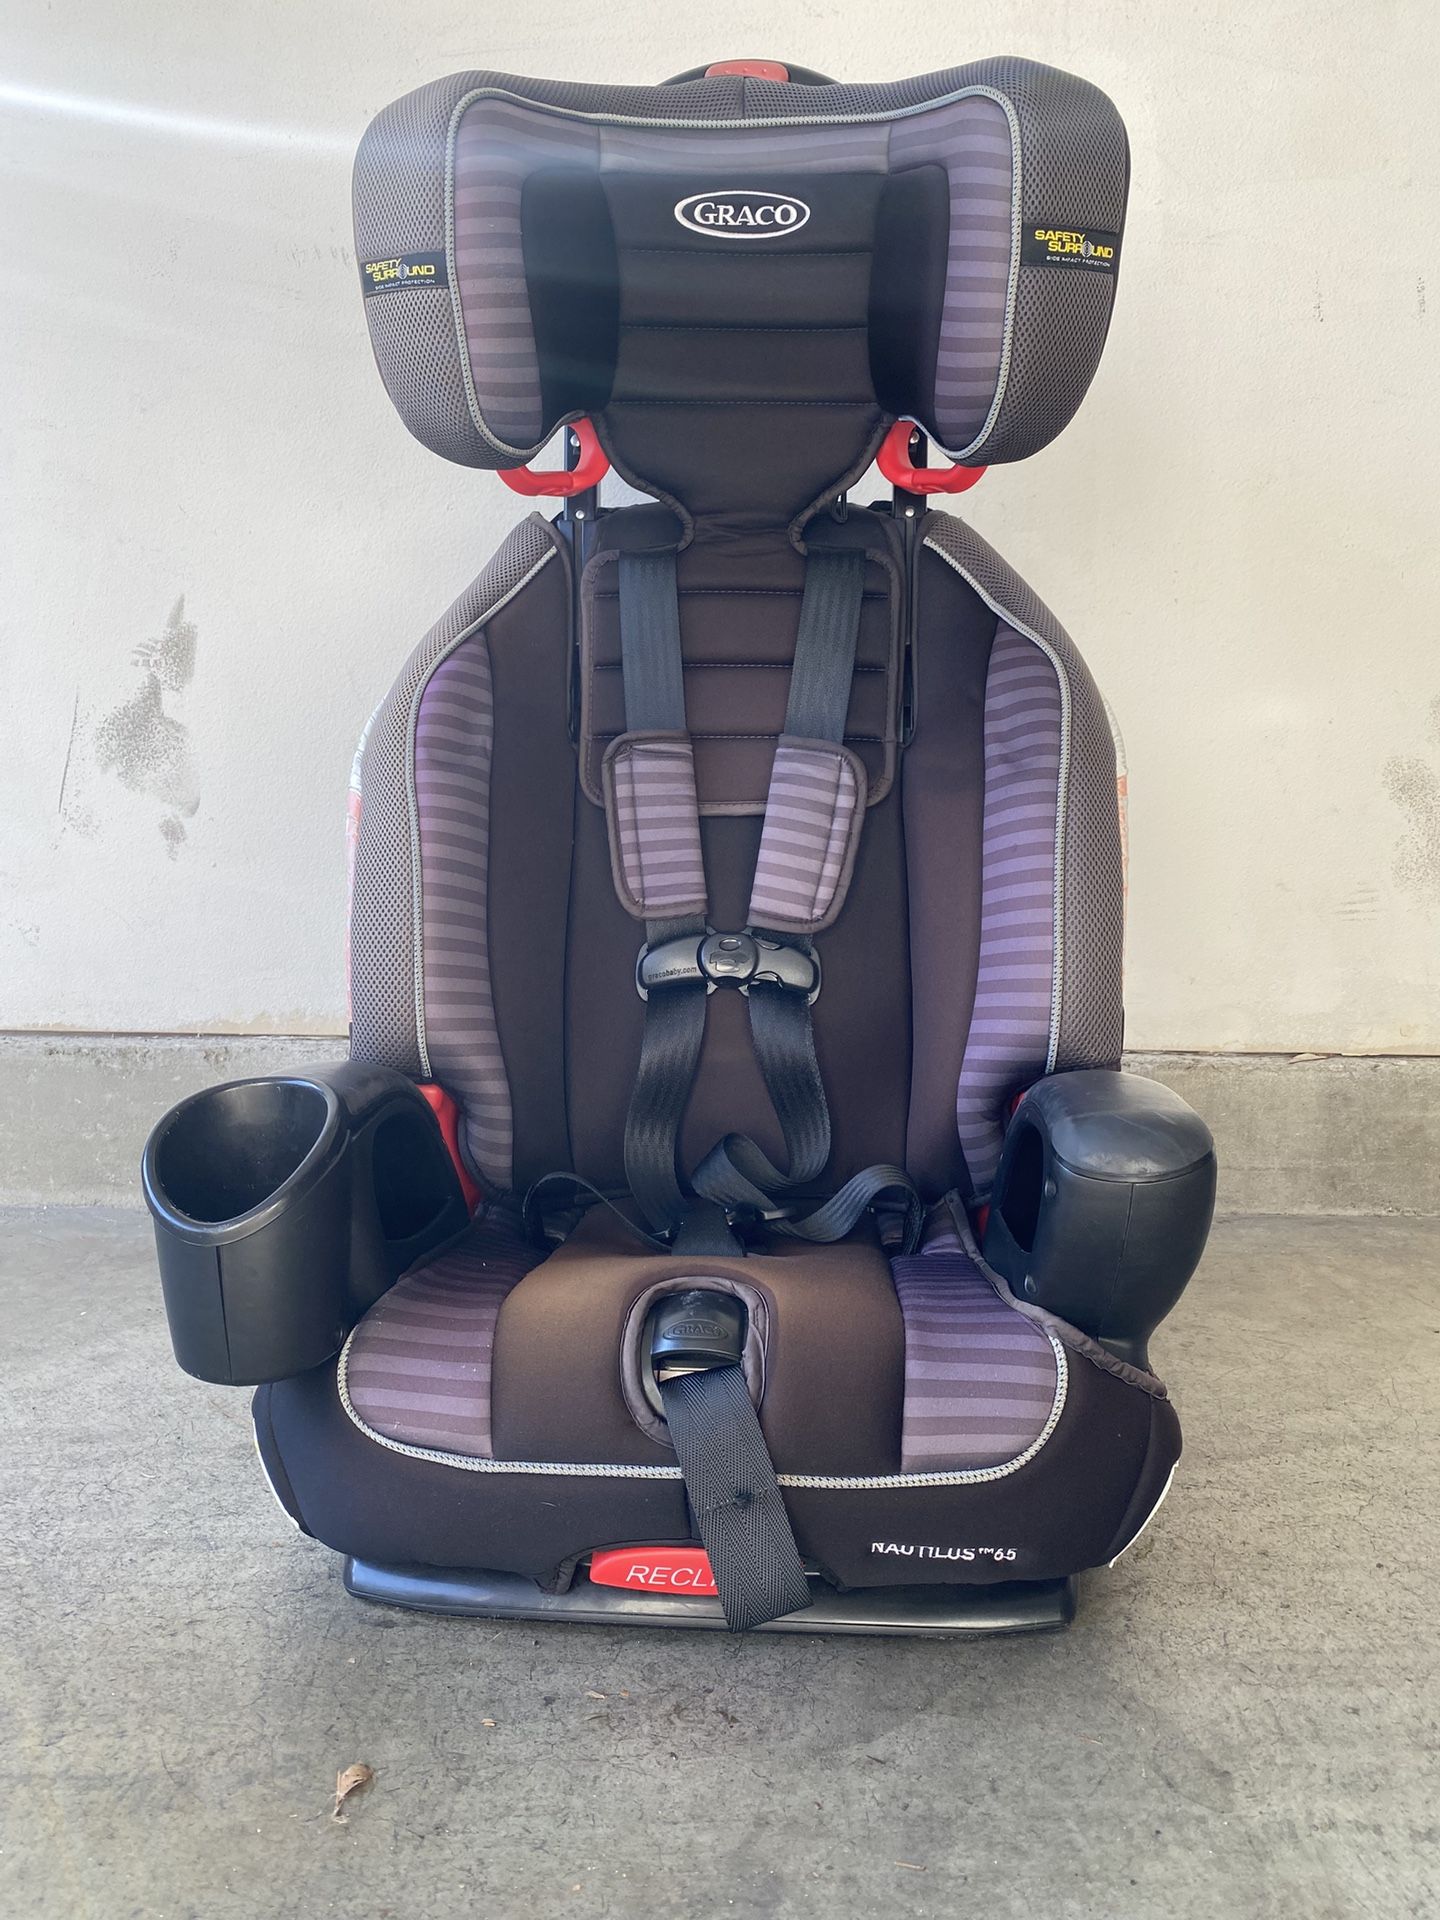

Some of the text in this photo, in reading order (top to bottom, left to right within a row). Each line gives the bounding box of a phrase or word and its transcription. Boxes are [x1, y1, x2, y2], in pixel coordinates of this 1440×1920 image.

[693, 202, 798, 226] GRACO
[1034, 229, 1086, 244] SAFETY
[1047, 240, 1114, 259] SURROUND
[365, 257, 402, 274] SAFETY
[372, 263, 436, 282] SURROUND
